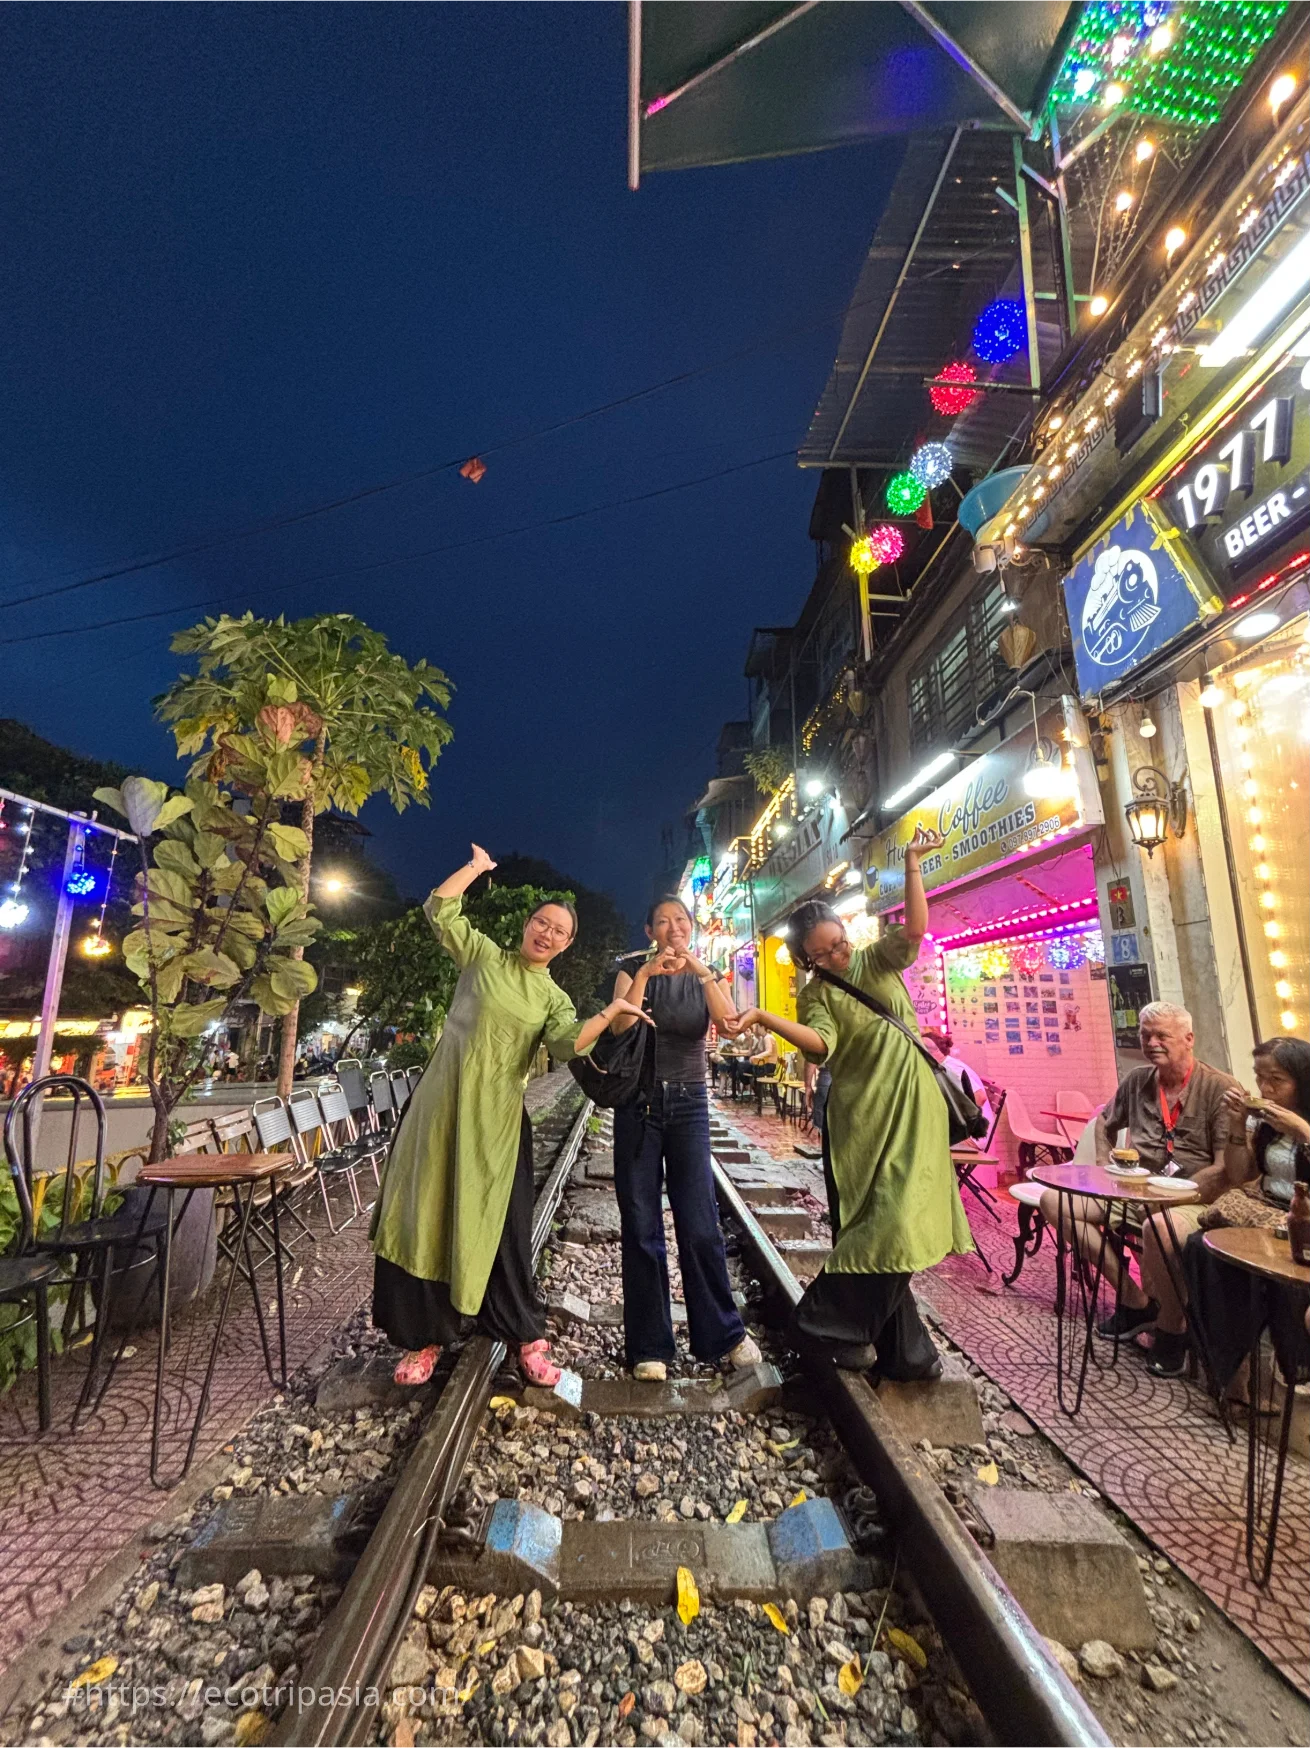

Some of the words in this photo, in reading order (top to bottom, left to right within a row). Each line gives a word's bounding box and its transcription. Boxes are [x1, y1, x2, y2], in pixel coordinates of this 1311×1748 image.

[1177, 398, 1280, 529] 1977
[1224, 492, 1291, 558] BEER
[919, 854, 942, 875] EER
[952, 802, 1035, 860] SMOOTHIES
[939, 776, 1008, 837] Coffee
[1121, 938, 1130, 958] 8
